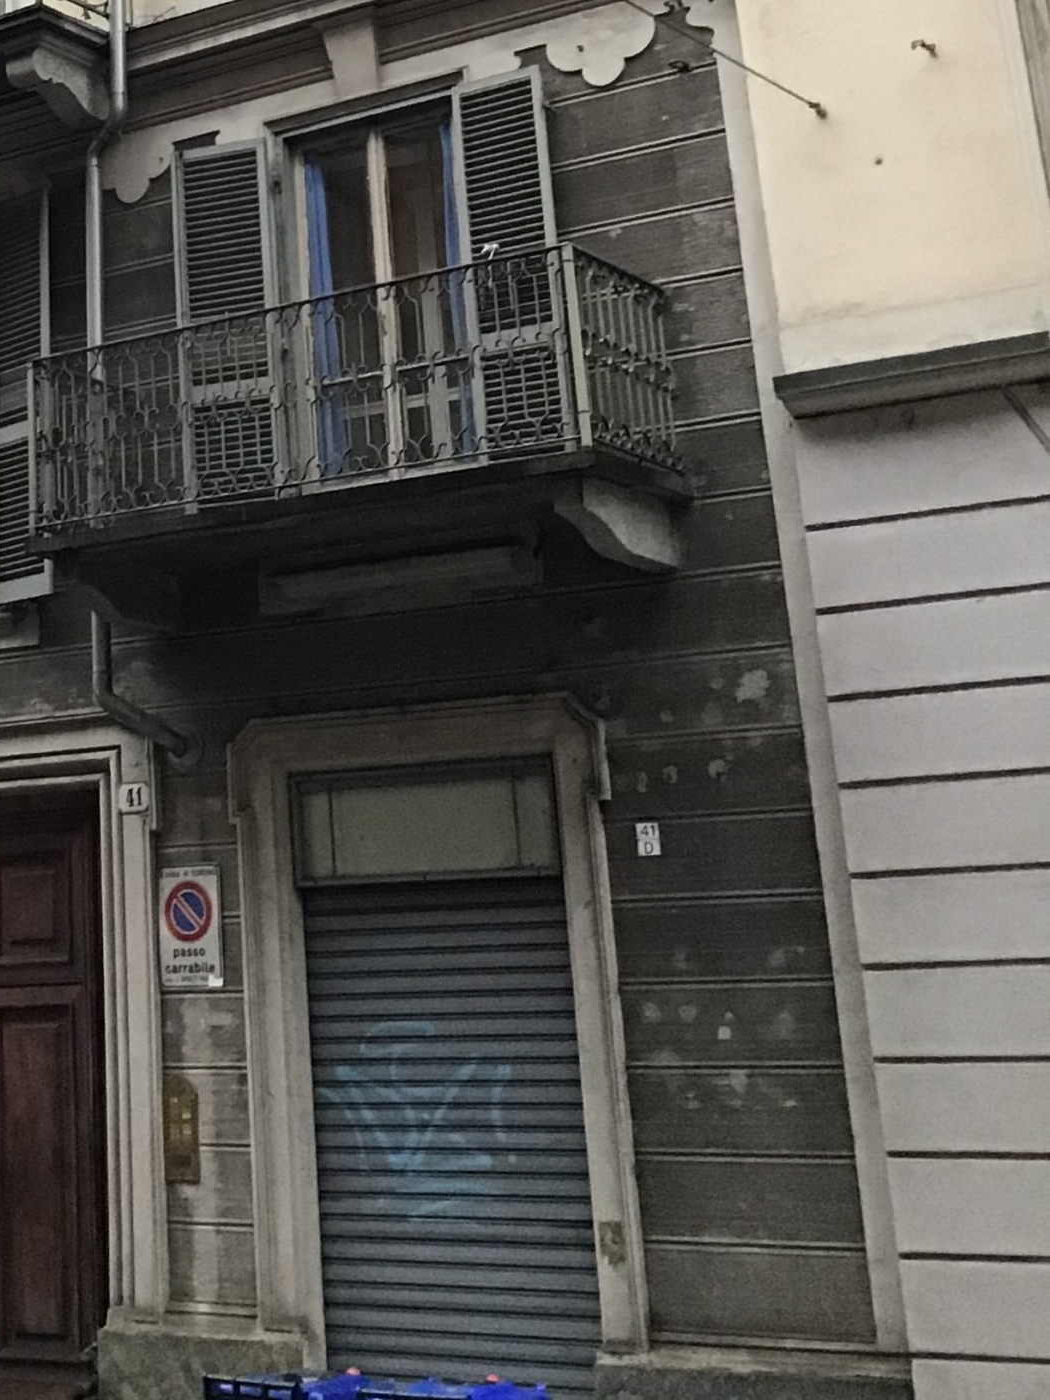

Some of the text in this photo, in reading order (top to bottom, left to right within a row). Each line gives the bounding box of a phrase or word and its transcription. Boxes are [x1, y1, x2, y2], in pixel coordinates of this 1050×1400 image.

[126, 786, 143, 807] 41
[640, 824, 655, 836] 41
[644, 841, 654, 855] D
[173, 947, 206, 959] passo
[165, 961, 216, 974] carrabile
